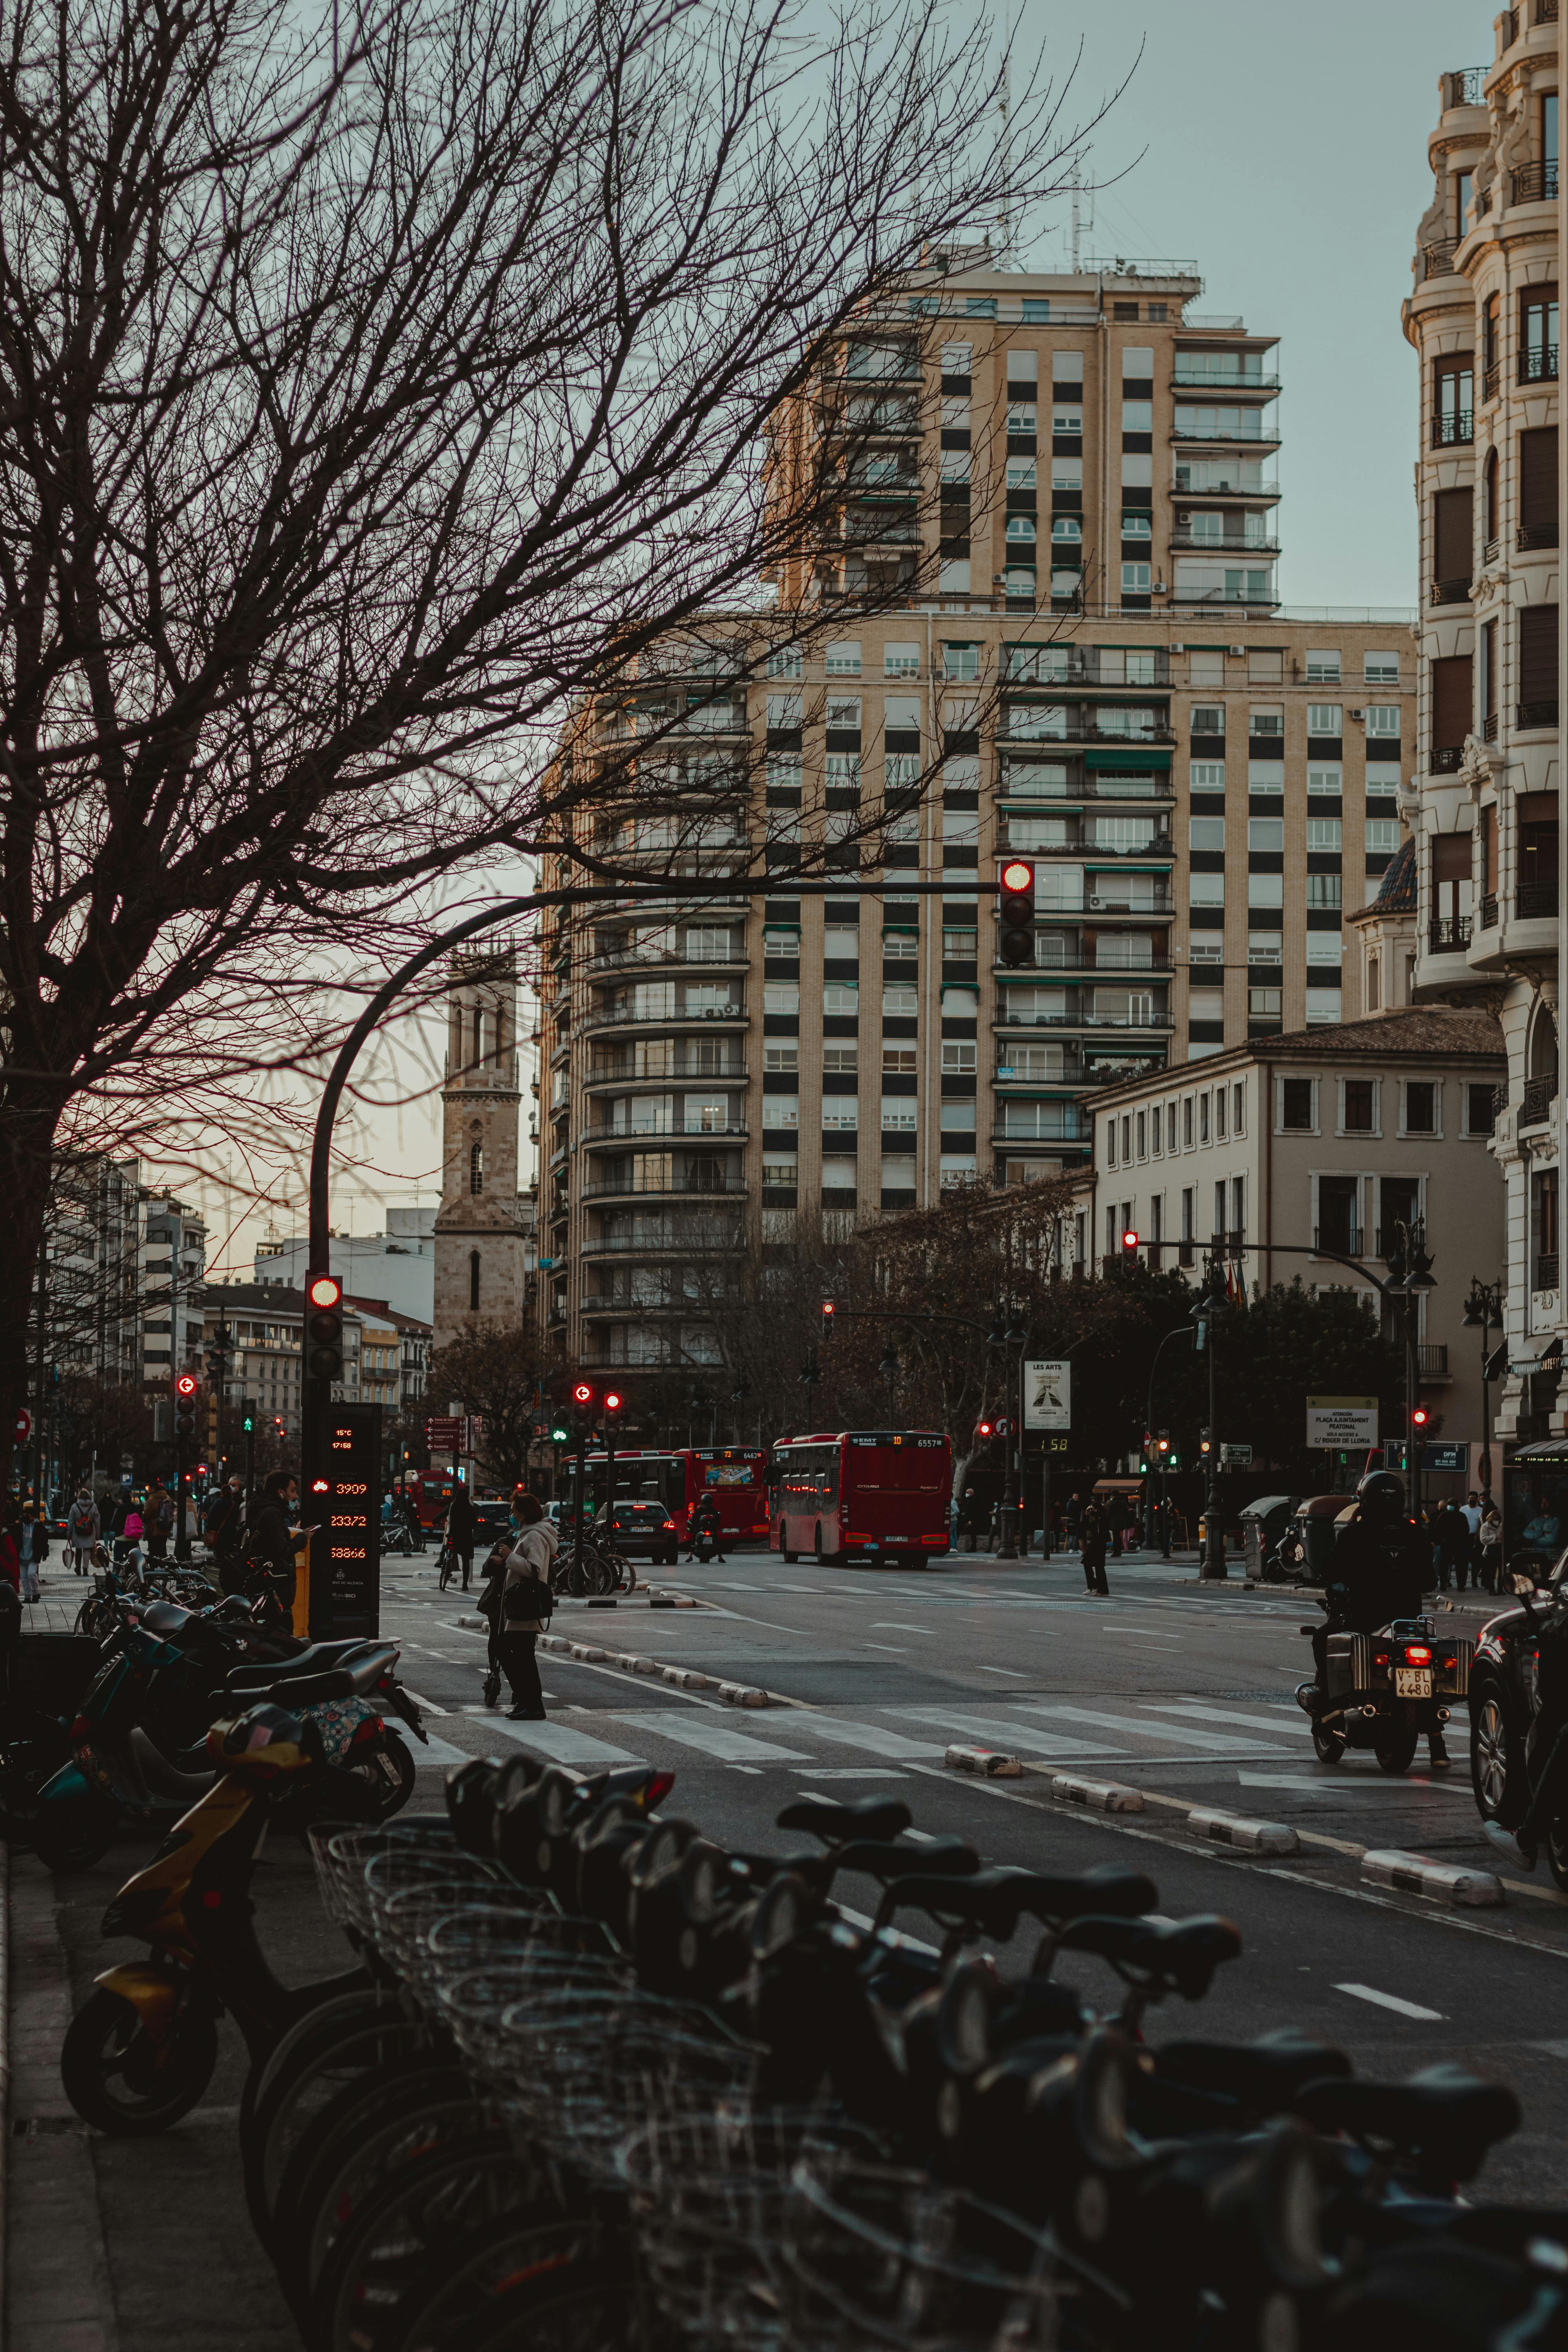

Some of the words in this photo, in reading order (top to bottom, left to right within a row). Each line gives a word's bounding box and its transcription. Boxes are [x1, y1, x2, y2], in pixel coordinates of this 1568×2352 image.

[894, 1436, 901, 1445] 10
[1051, 1439, 1067, 1450] 58
[336, 1484, 367, 1494] 3909
[1399, 1683, 1430, 1695] 4480
